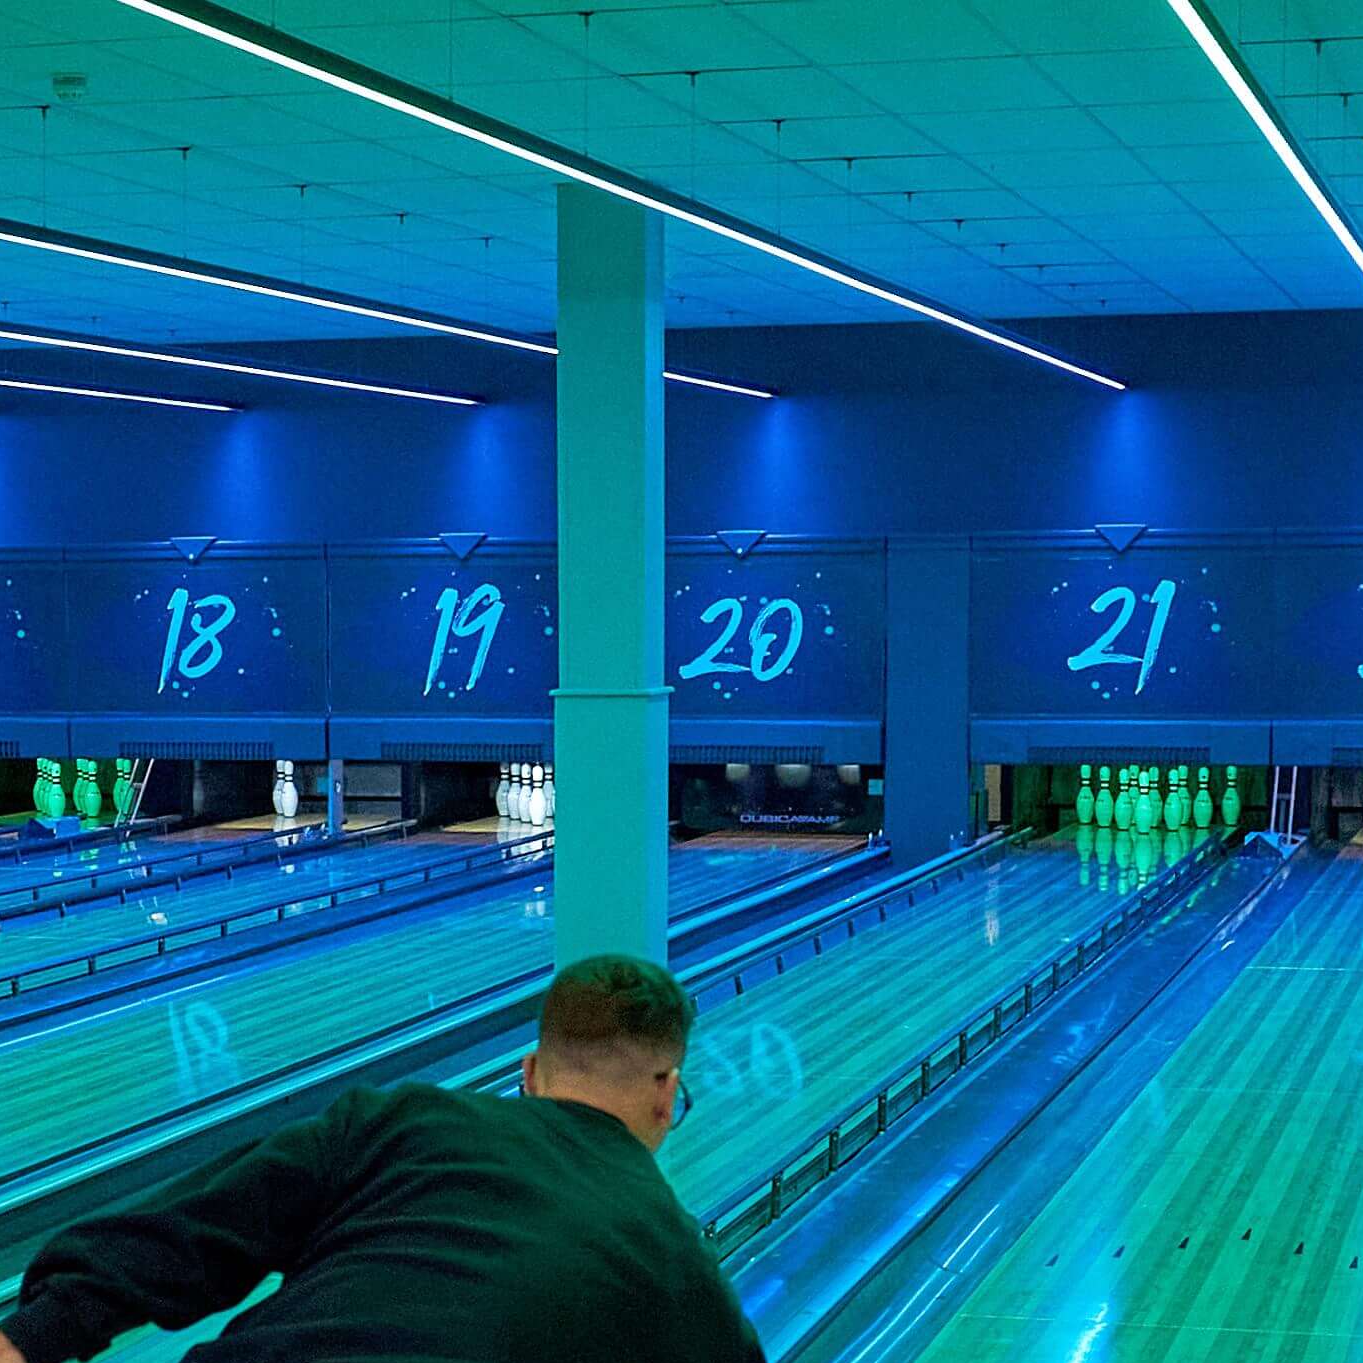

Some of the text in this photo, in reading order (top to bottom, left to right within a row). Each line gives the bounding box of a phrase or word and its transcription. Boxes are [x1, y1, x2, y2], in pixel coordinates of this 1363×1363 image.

[157, 587, 236, 694] 18
[423, 584, 505, 696] 19
[679, 597, 803, 681] 20
[1067, 579, 1176, 695] 21
